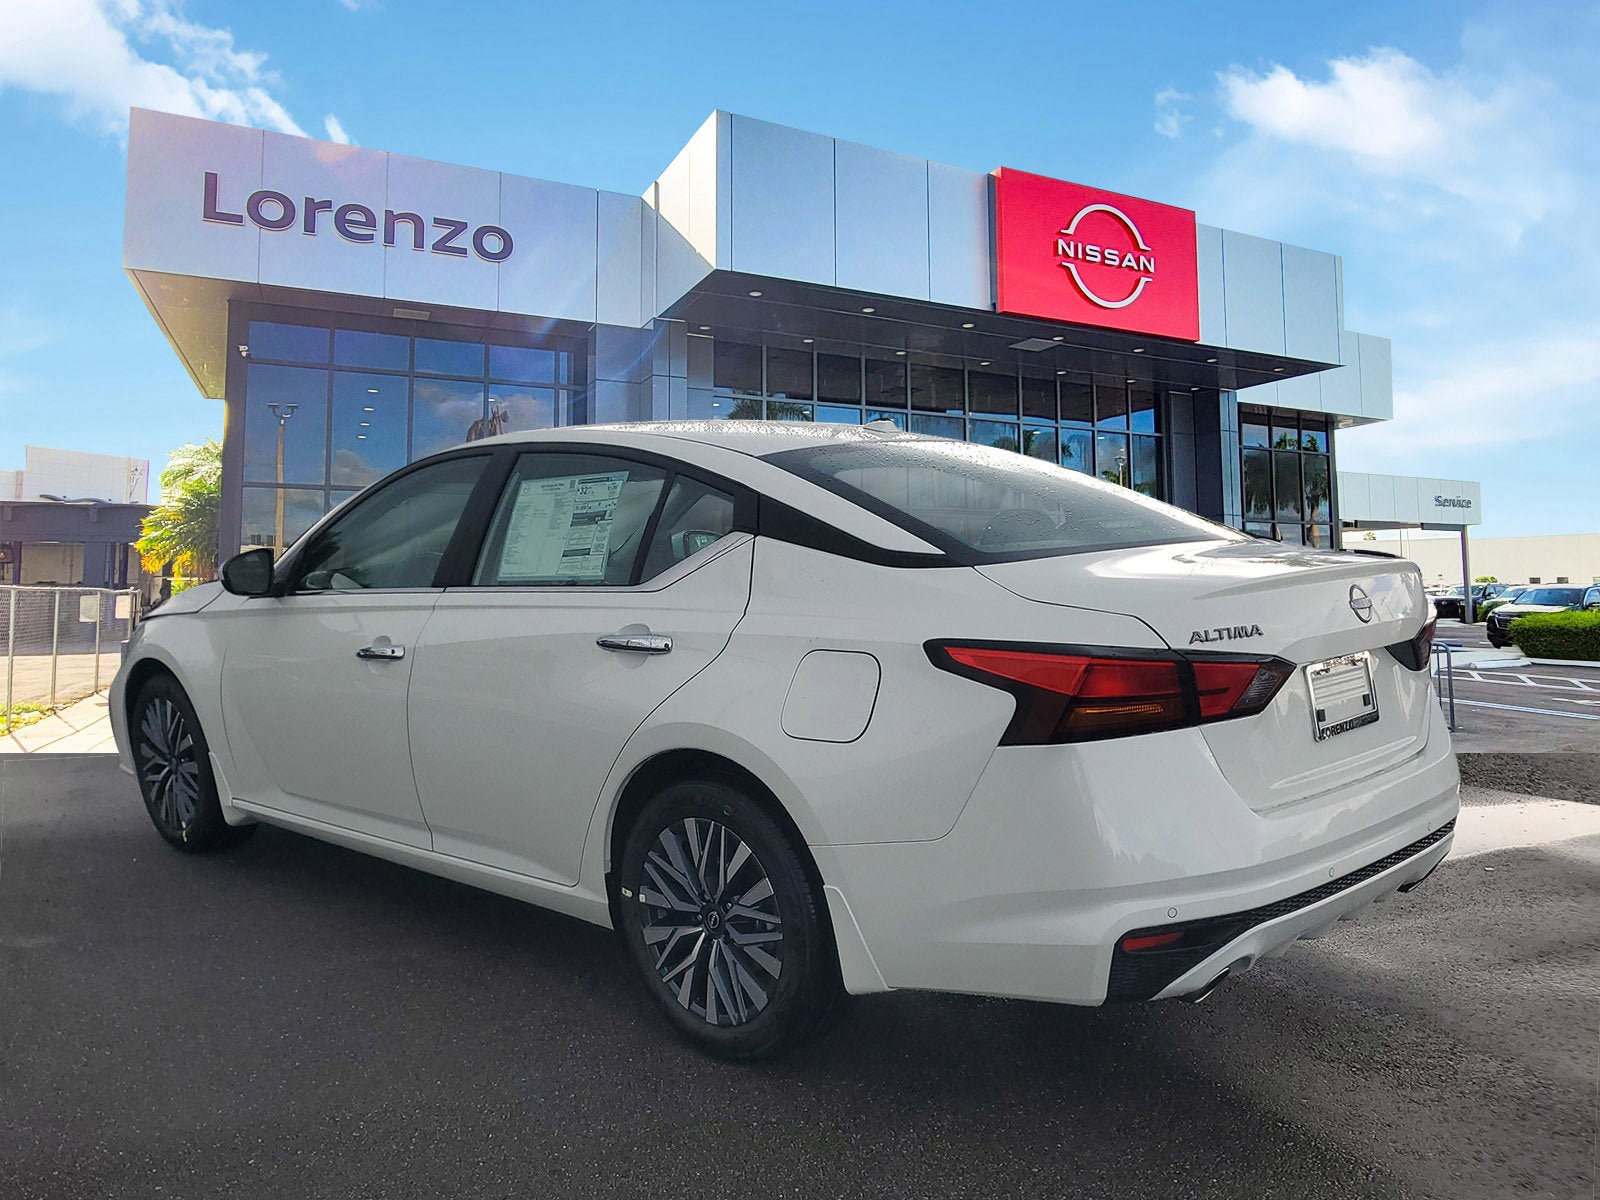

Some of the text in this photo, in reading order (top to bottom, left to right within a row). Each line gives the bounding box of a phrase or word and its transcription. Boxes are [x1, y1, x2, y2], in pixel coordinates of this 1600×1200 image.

[202, 170, 515, 263] Lorenzo
[1057, 238, 1155, 274] NISSAN
[1435, 495, 1472, 509] Service
[1189, 624, 1264, 645] ALTIMA
